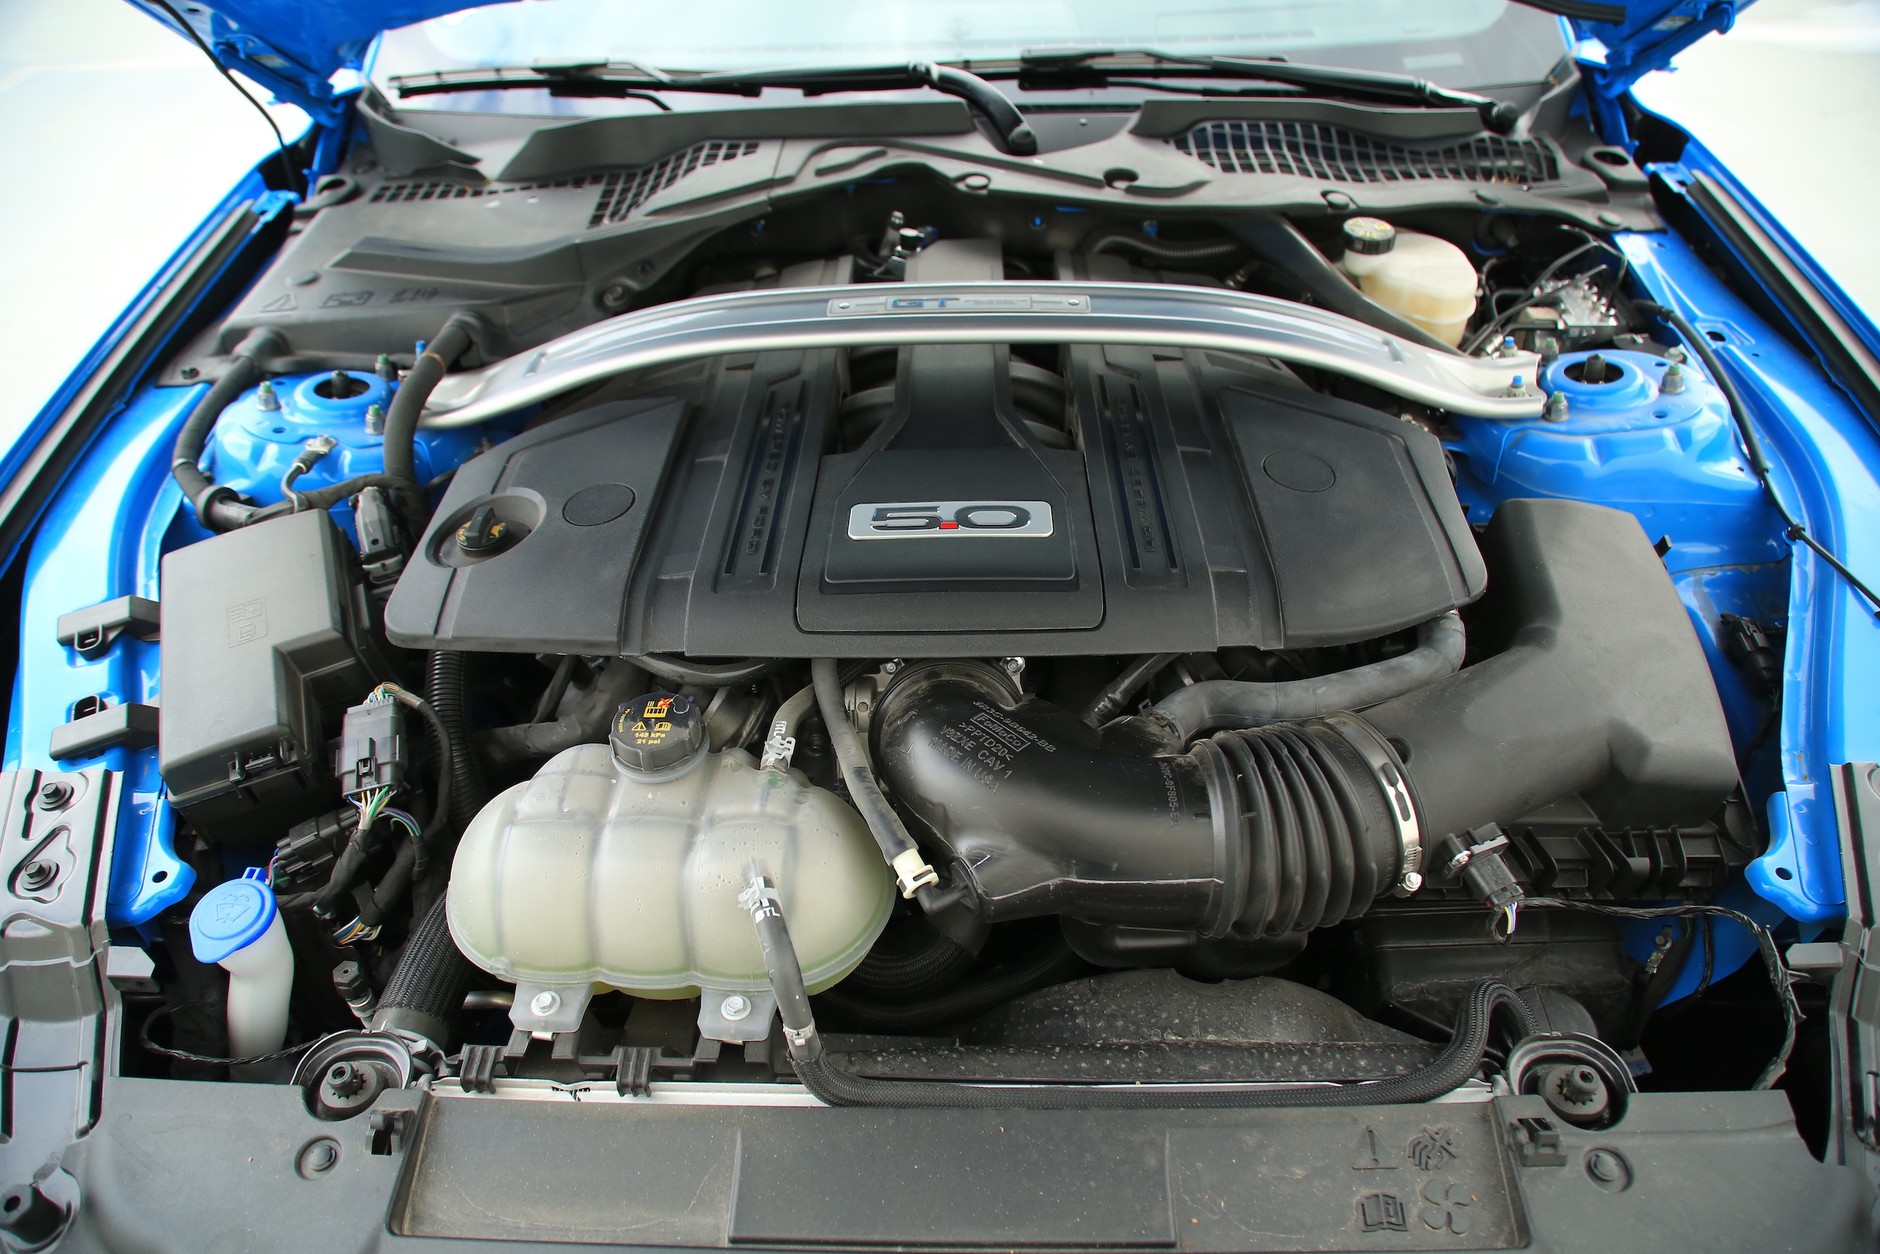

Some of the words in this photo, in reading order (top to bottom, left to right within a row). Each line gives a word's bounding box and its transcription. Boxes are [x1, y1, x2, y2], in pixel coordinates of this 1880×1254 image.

[892, 297, 961, 308] GT
[870, 505, 1032, 531] 5.0
[977, 715, 1022, 747] FoMoCo
[928, 736, 963, 763] MADE
[960, 756, 977, 773] IN
[974, 767, 1000, 795] USA
[977, 750, 1005, 771] CAV
[755, 906, 781, 924] BTL
